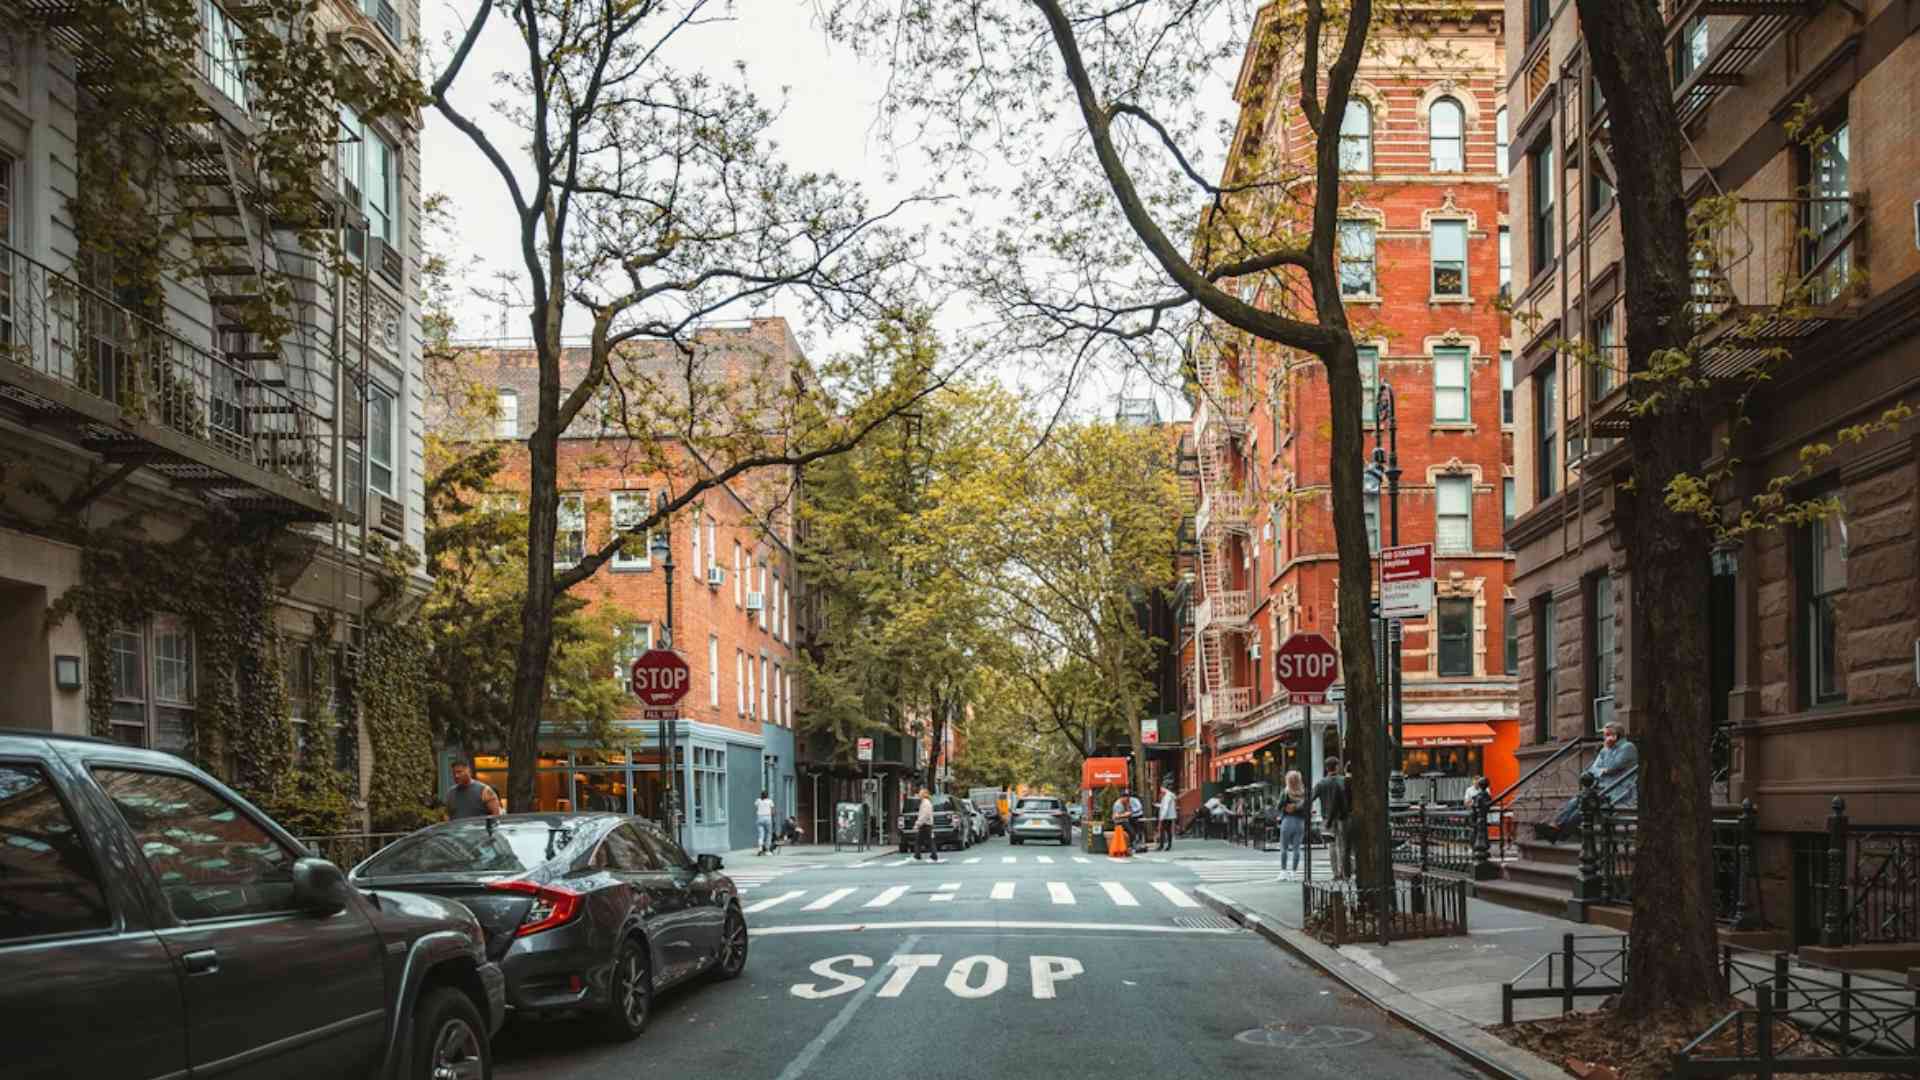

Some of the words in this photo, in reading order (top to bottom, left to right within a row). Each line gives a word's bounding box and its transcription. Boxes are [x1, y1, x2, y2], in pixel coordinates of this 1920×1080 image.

[1279, 653, 1335, 678] STOP
[635, 667, 687, 690] STOP
[1292, 694, 1306, 704] ALL
[1308, 694, 1323, 704] WAY
[646, 710, 660, 719] ALL
[790, 953, 1085, 1000] STOP
